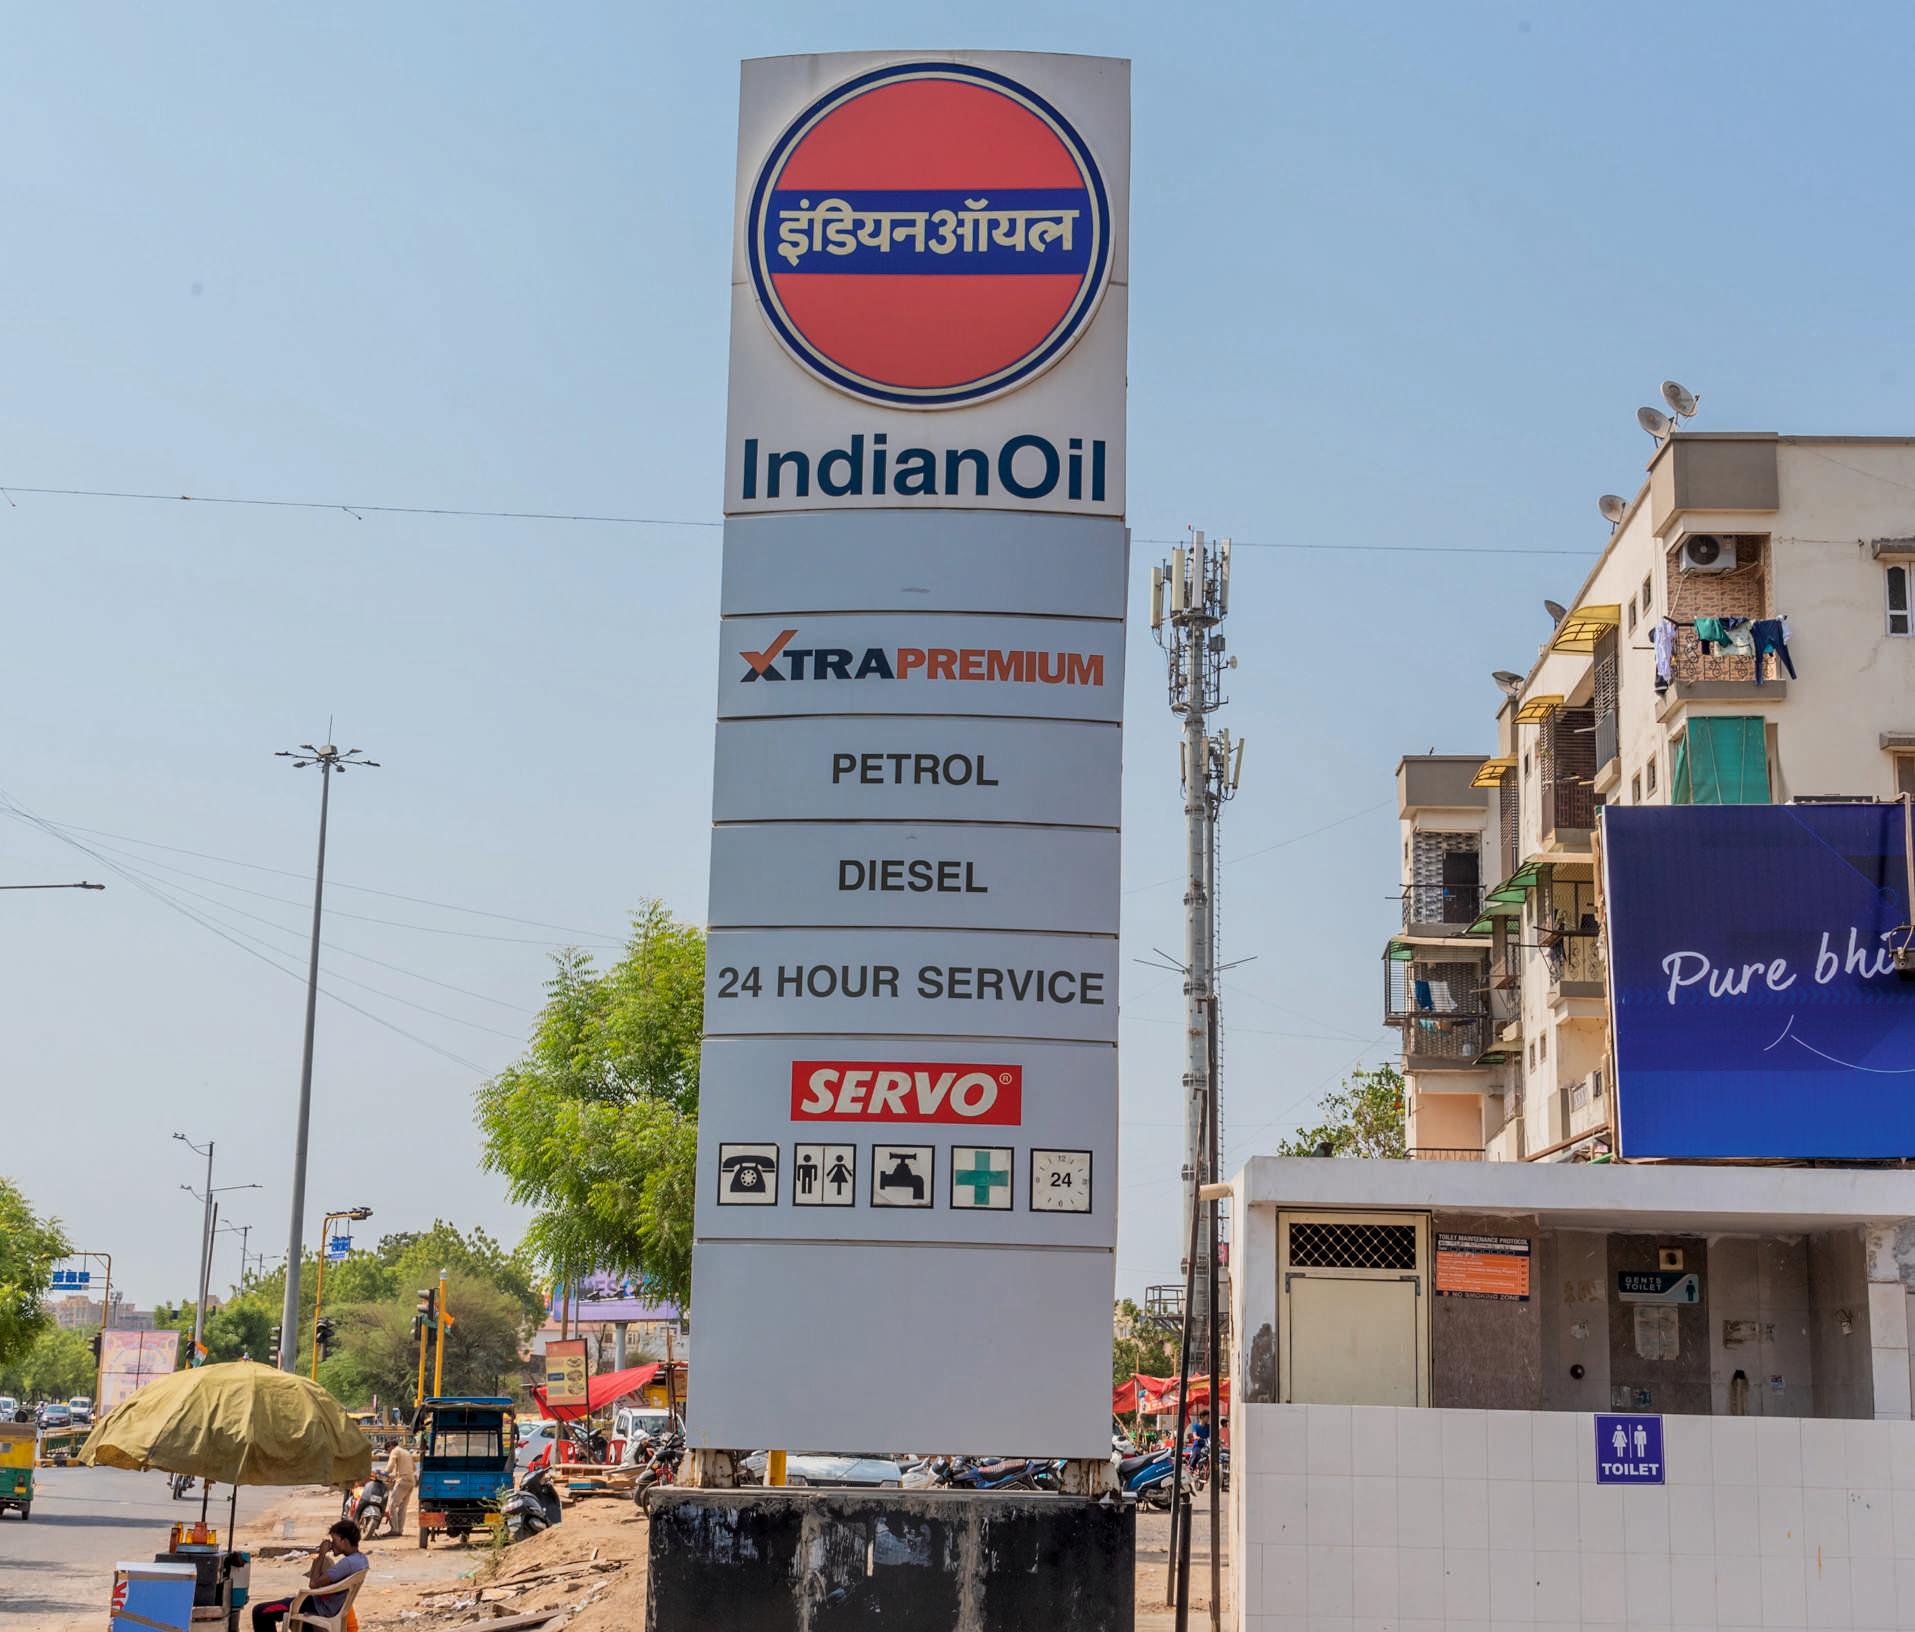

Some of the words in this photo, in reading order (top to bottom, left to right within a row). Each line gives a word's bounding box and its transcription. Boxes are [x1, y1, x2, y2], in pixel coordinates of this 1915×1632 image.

[777, 198, 1080, 267] इंडियनऑयल
[742, 433, 1106, 502] IndianOil
[832, 753, 999, 786] PETROL
[838, 859, 988, 893] DIESEL
[717, 966, 762, 999] 24
[777, 965, 900, 998] HOUR
[917, 966, 1105, 1005] SERVICE
[1662, 951, 1797, 1005] Pure
[1051, 1172, 1072, 1187] 24
[1625, 1276, 1662, 1284] GENTS
[1625, 1283, 1662, 1291] TOILET
[1601, 1463, 1660, 1476] TOILET
